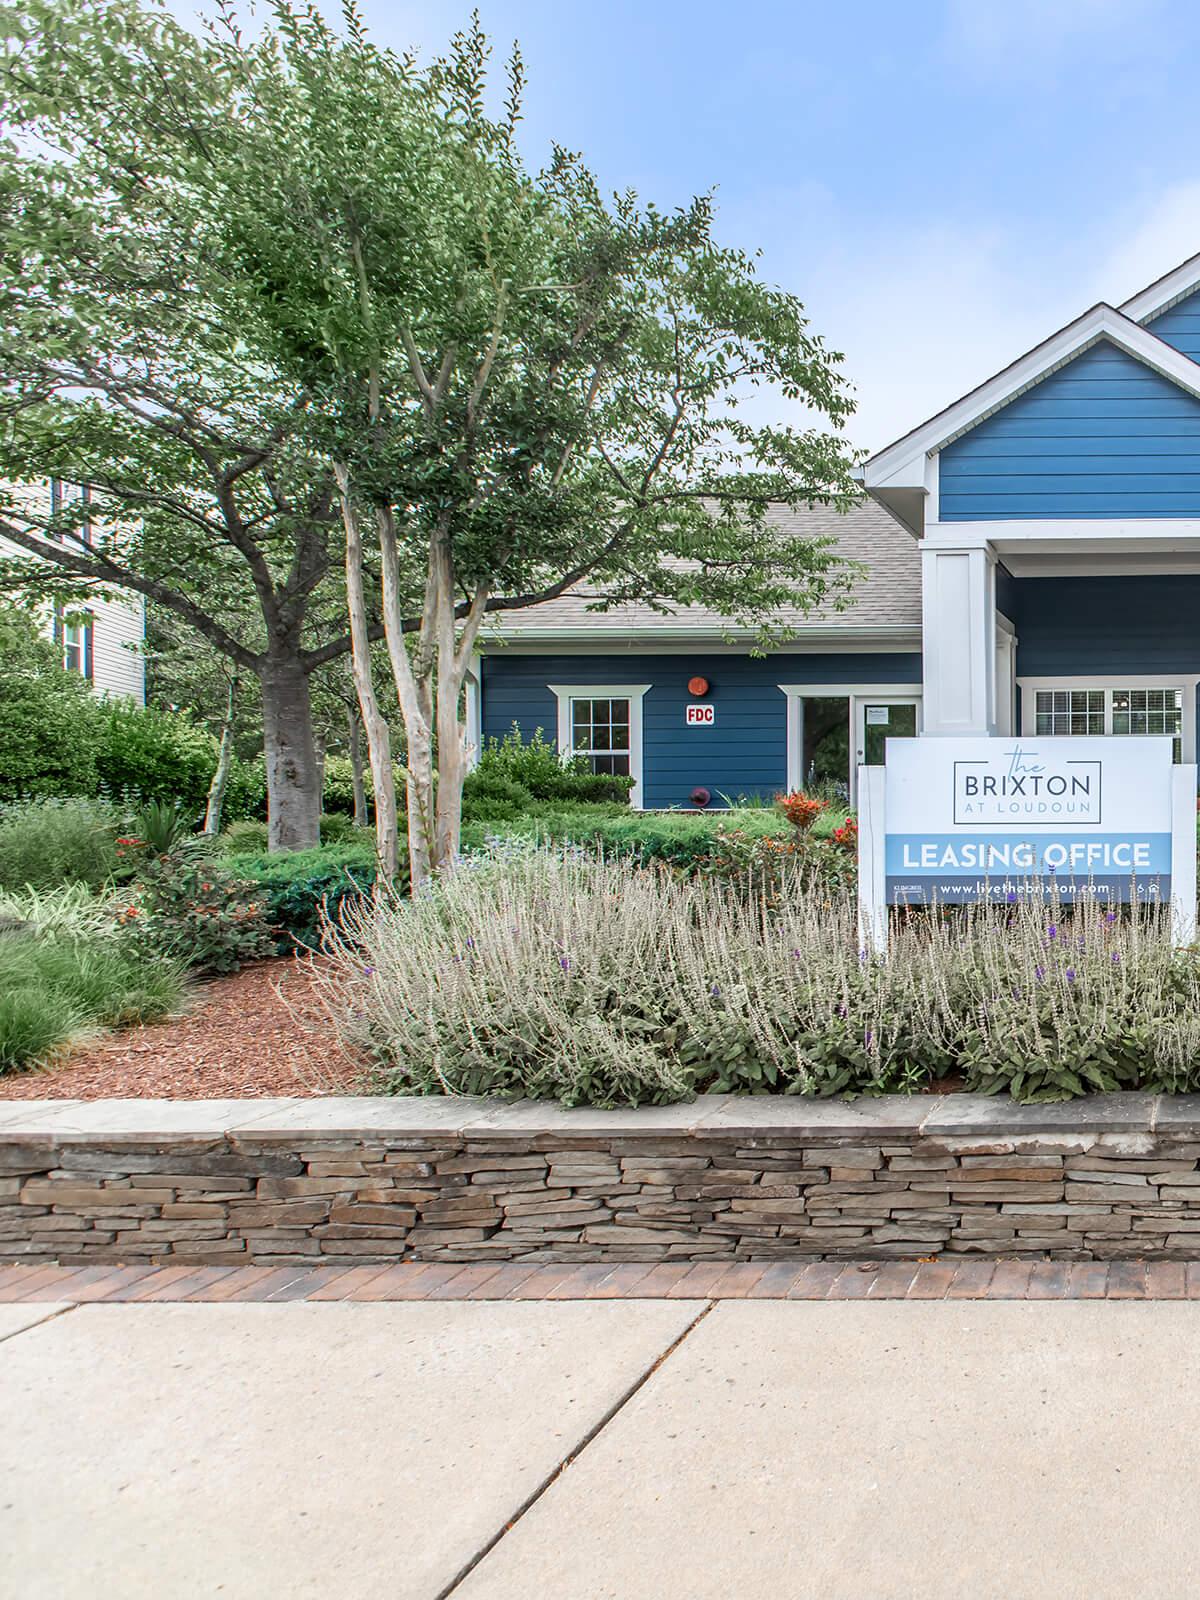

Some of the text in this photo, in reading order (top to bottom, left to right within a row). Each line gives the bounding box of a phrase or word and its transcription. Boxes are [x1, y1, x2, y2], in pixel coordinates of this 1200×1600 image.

[688, 708, 713, 722] FDC
[1003, 744, 1046, 781] the
[965, 775, 1090, 796] BRIXTON
[965, 802, 1090, 813] AT LOUDOUN
[903, 843, 1150, 868] LEASING OFFICE
